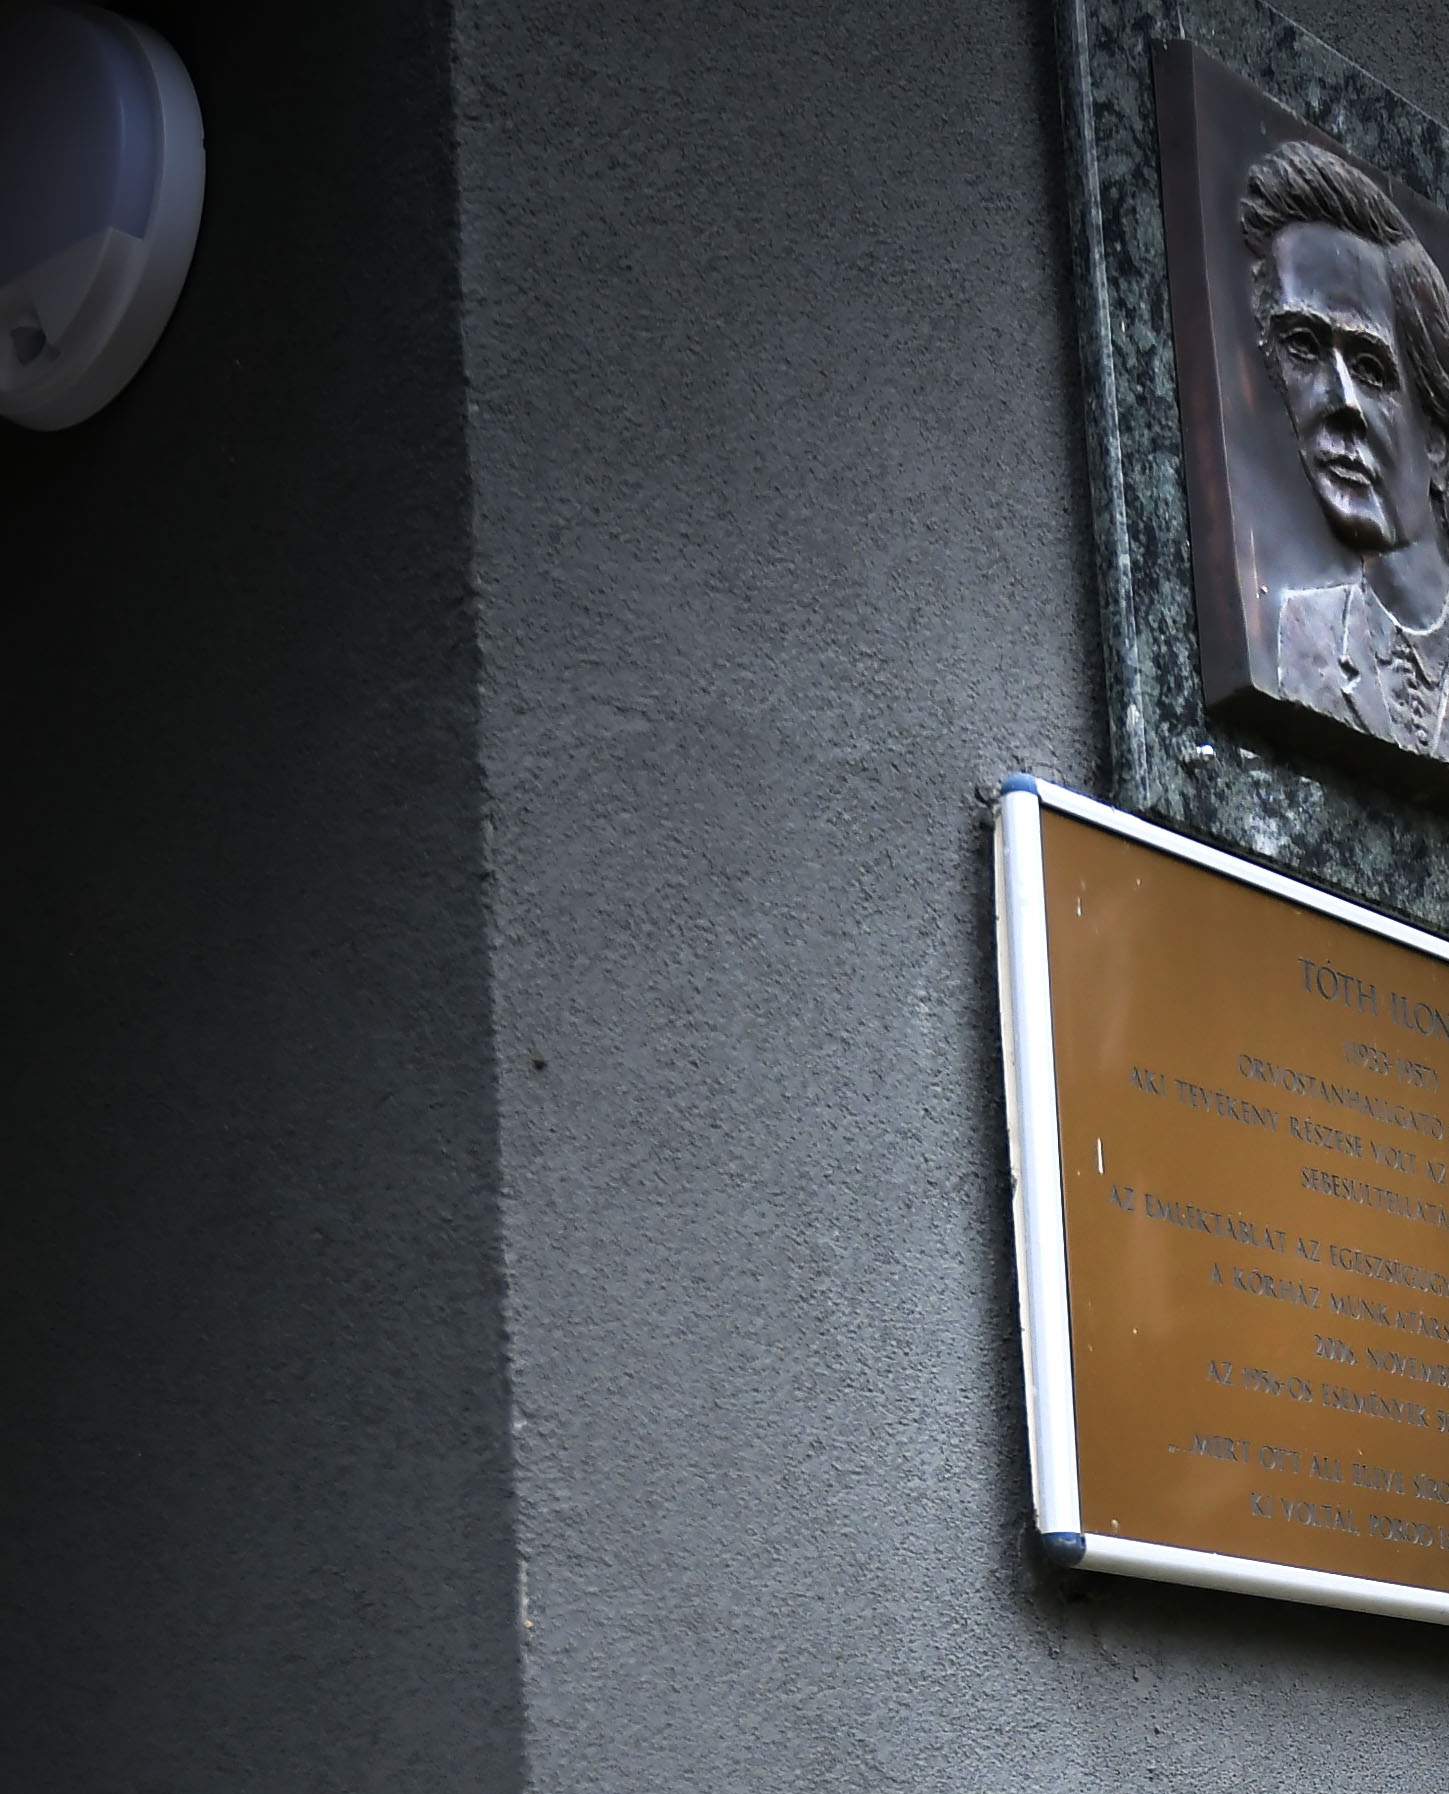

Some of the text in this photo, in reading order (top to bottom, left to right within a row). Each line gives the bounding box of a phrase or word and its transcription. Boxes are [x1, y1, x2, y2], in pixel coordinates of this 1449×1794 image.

[1298, 958, 1377, 1017] TÓTH
[1130, 1066, 1165, 1097] AKI
[1176, 1081, 1280, 1133] TEVÉKENY
[1289, 1115, 1363, 1159] RÉSZESE
[1371, 1141, 1416, 1176] VOLT
[1426, 1160, 1449, 1185] AZ
[1108, 1184, 1135, 1213] AZ
[1296, 1236, 1321, 1262] AZ
[1210, 1262, 1223, 1284] A
[1233, 1267, 1320, 1309] KÓRHÁZ
[1205, 1357, 1234, 1385] AZ
[1259, 1445, 1302, 1475] OTT
[1251, 1492, 1273, 1518] KI
